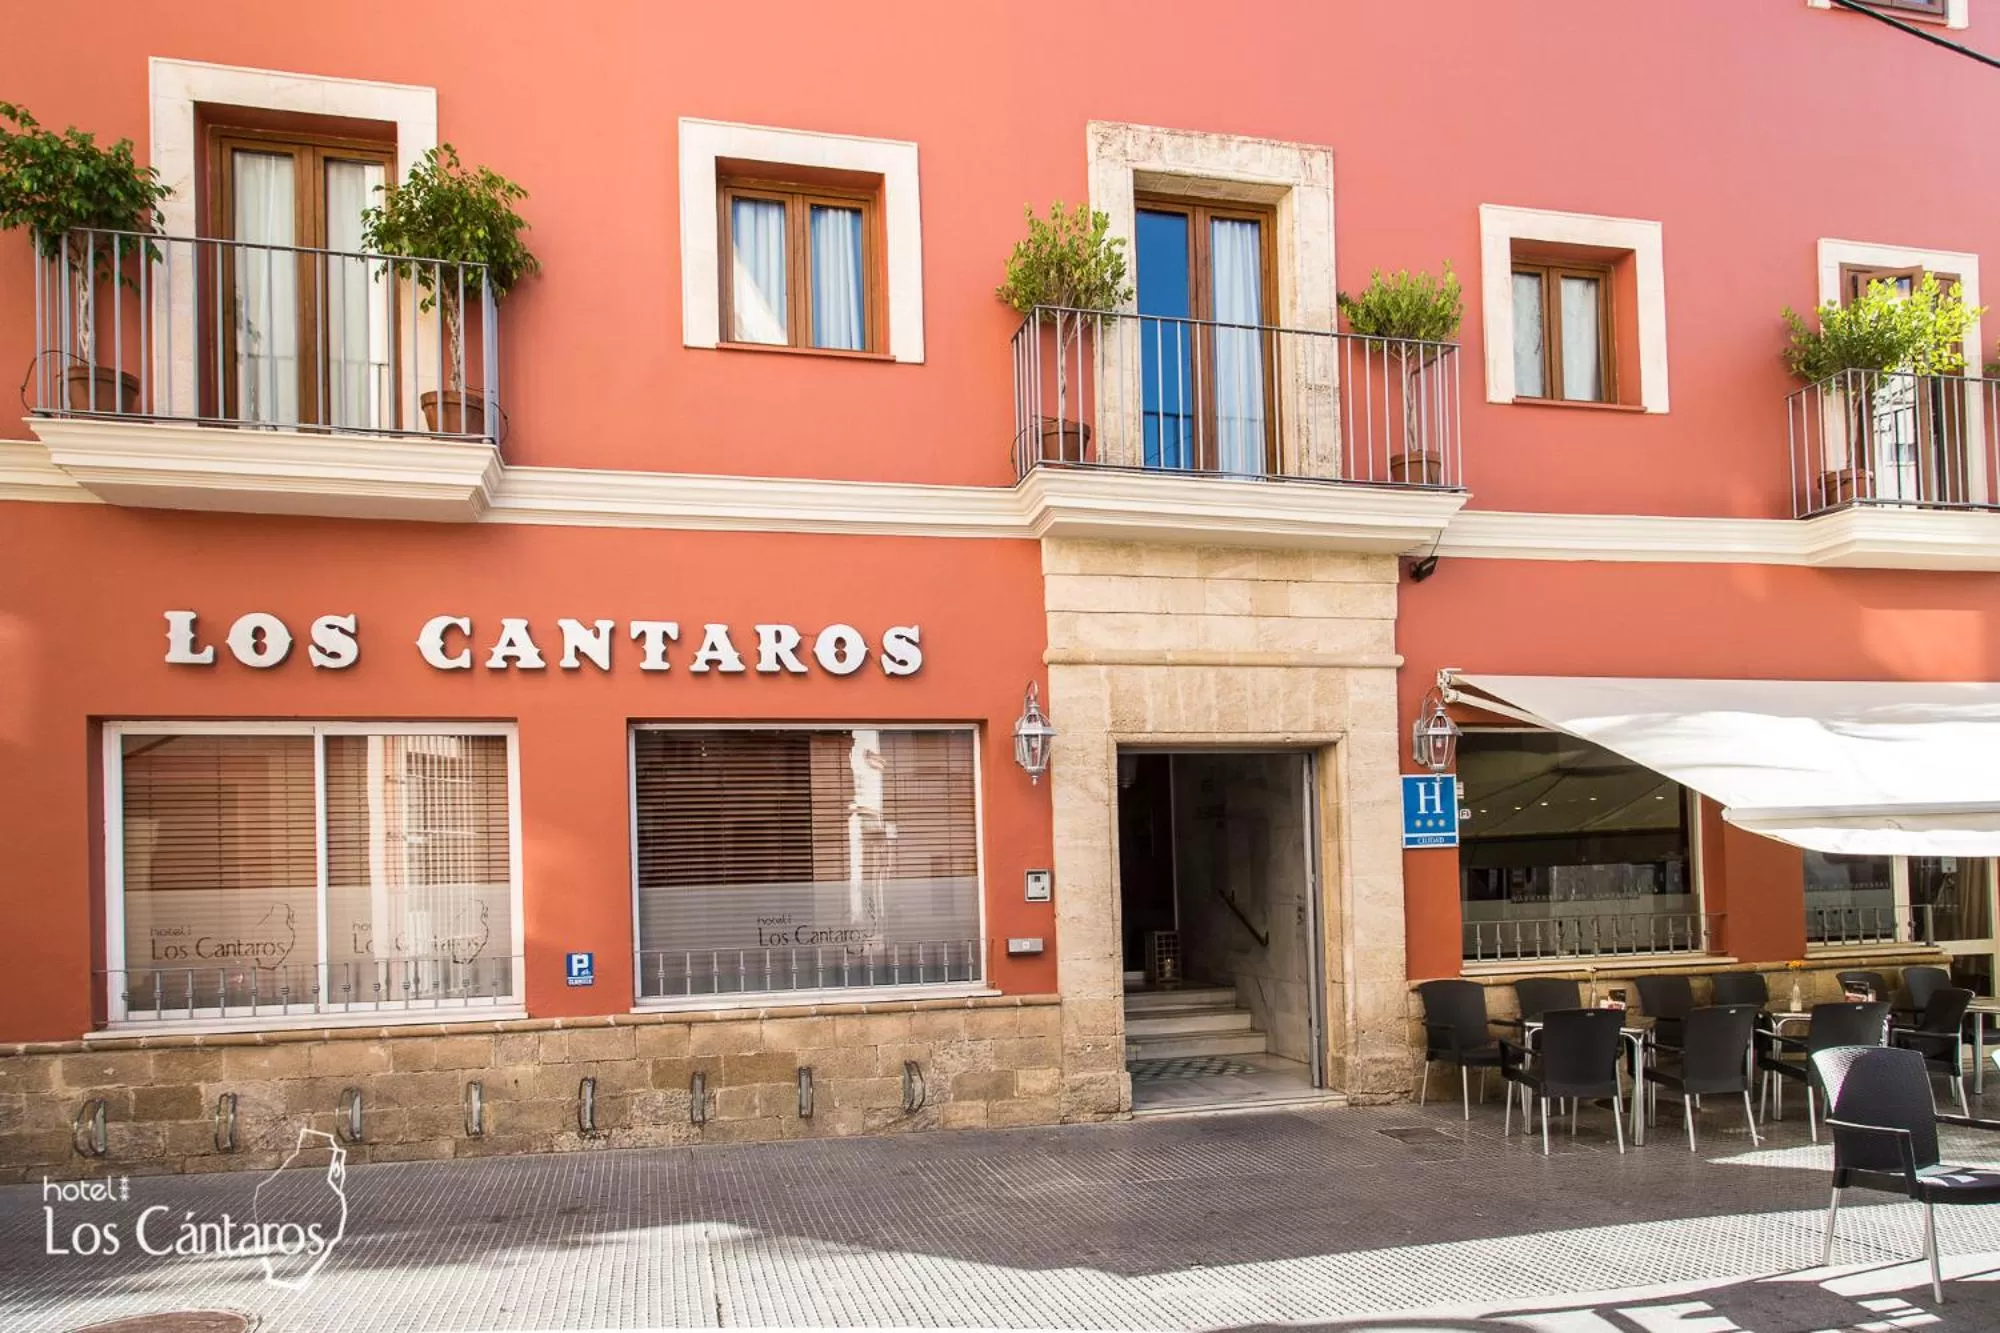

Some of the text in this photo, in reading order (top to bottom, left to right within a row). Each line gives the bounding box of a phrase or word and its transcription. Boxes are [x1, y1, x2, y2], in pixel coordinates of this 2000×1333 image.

[164, 610, 924, 676] LOS CANTAROS
[1416, 782, 1444, 814] H
[1417, 837, 1444, 845] CIUDAD
[150, 936, 286, 961] Los Cantaros
[757, 927, 789, 947] Los
[572, 954, 588, 976] P
